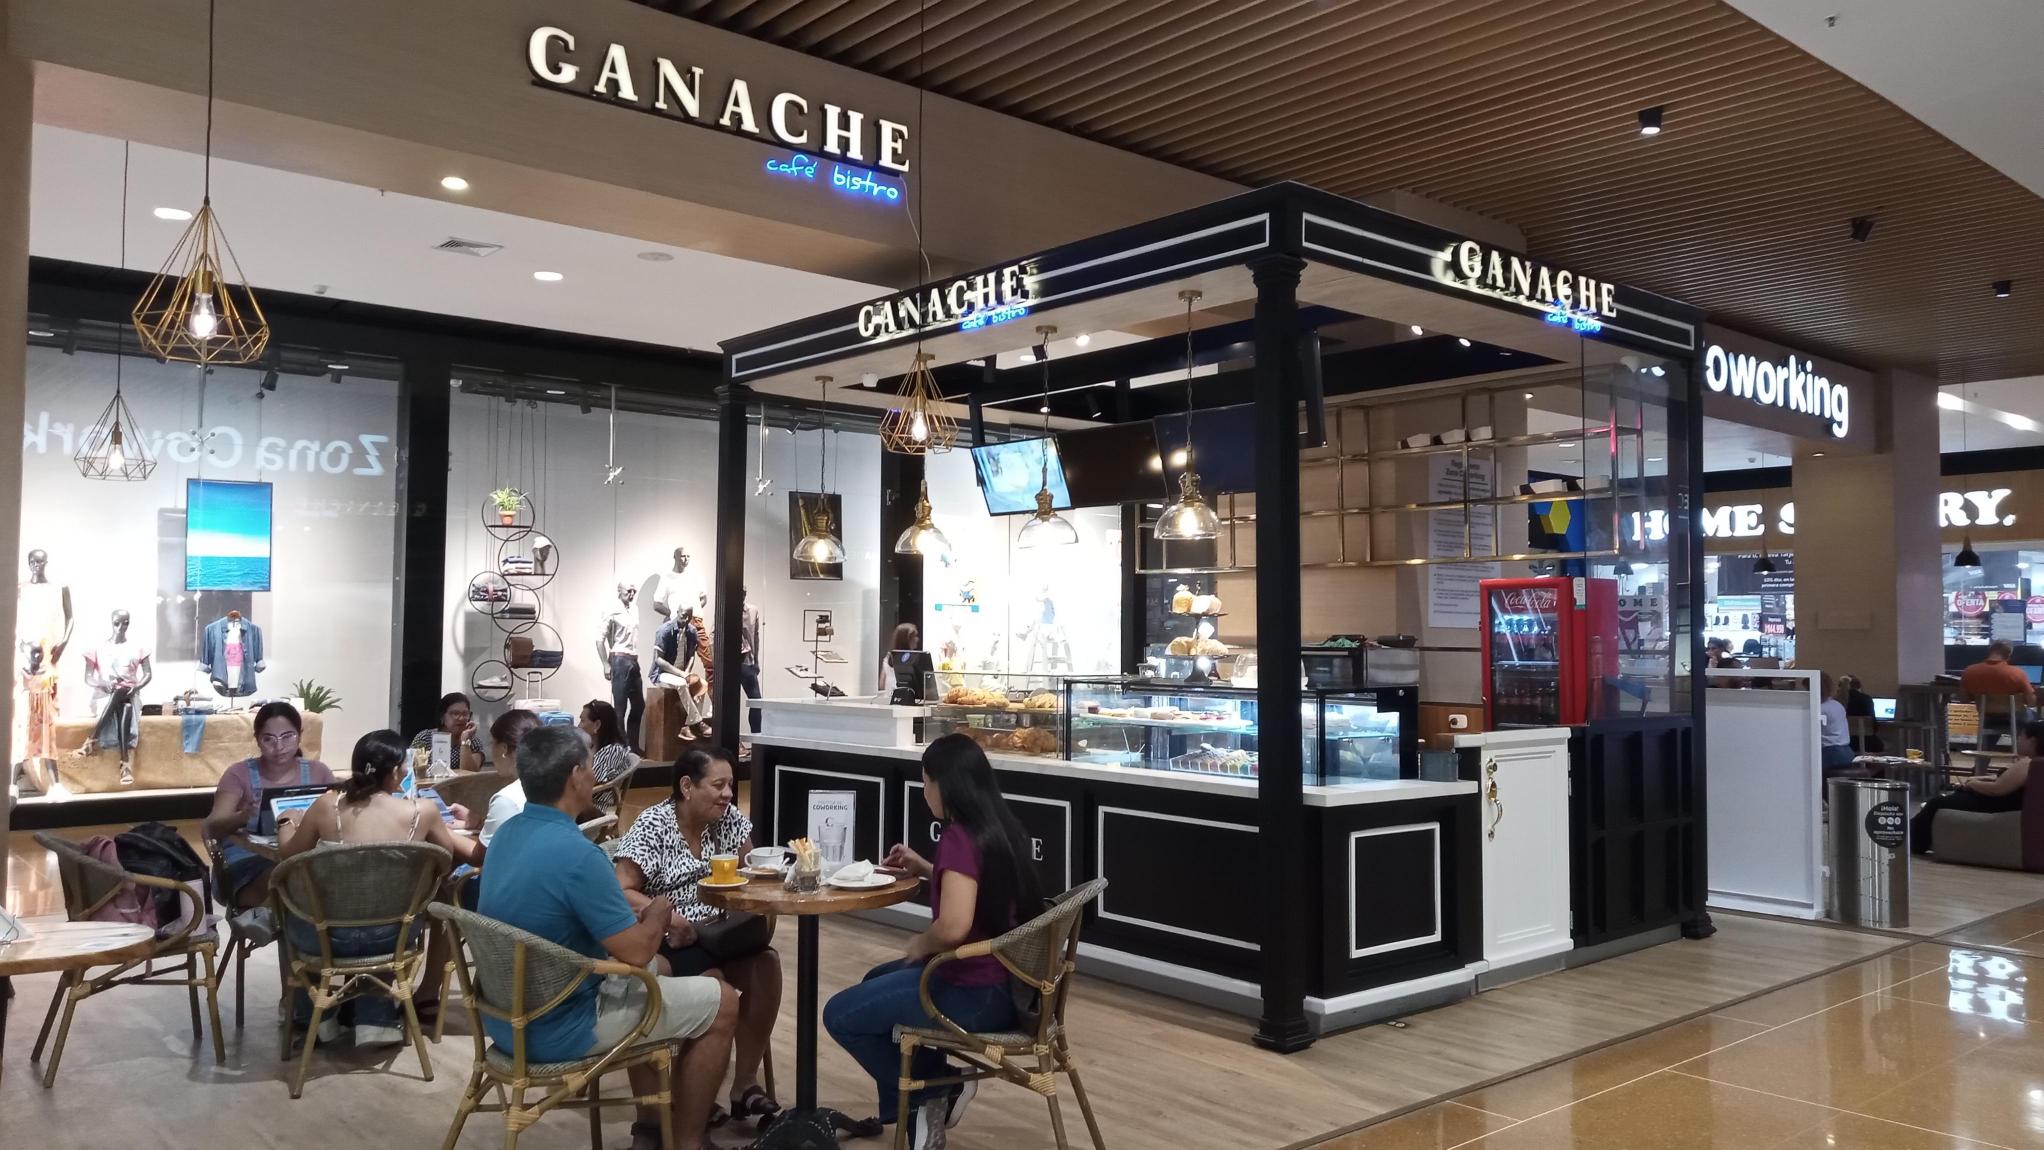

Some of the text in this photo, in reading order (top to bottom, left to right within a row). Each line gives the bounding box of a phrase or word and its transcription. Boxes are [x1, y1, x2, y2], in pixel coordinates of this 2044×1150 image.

[528, 26, 910, 173] GANACHE
[766, 154, 899, 200] café bistro
[858, 264, 1022, 338] GANACHE
[1459, 240, 1617, 318] GANACHE
[1704, 344, 1849, 439] oworking
